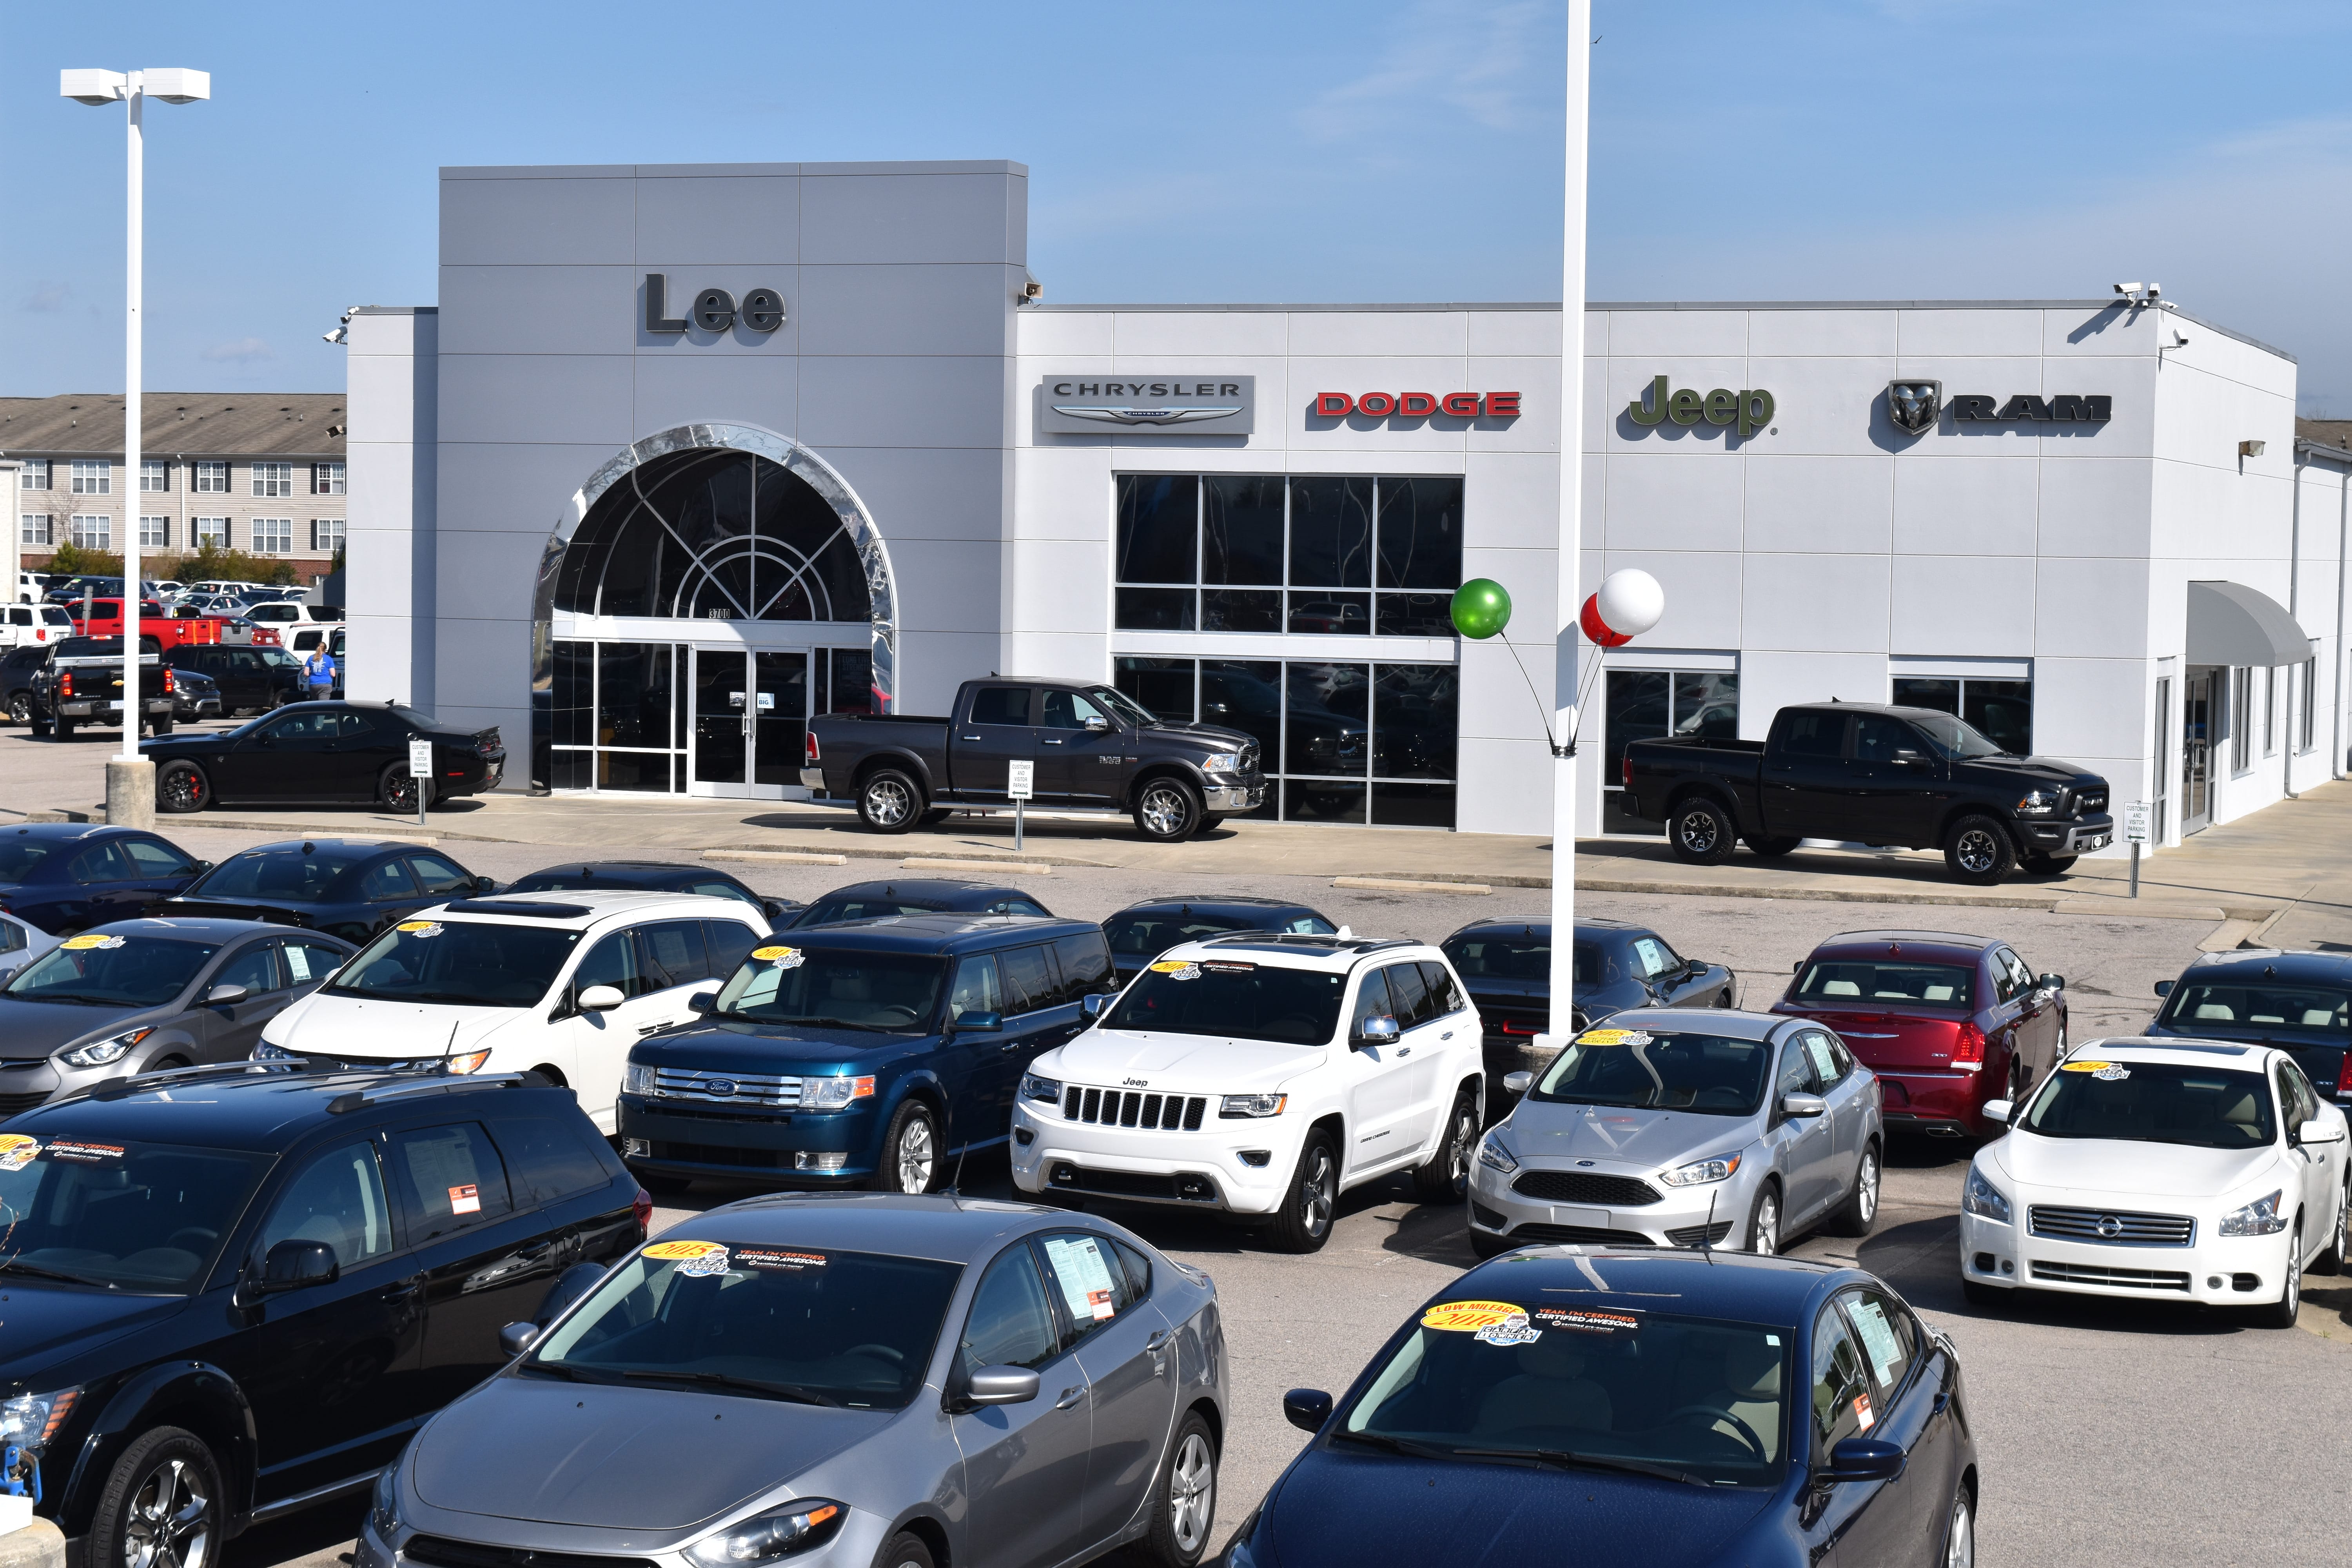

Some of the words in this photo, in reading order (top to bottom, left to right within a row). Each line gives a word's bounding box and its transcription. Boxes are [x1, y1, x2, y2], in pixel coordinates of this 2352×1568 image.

[645, 274, 785, 332] Lee
[1053, 383, 1240, 397] CHRYSLER
[1317, 392, 1522, 416] DODGE
[1630, 375, 1776, 436] Jeep
[1953, 395, 2112, 420] RAM
[710, 609, 730, 618] 3700
[710, 1082, 729, 1091] Ford
[1123, 1077, 1148, 1088] Jeep
[84, 1148, 124, 1157] AWESOME.
[85, 1143, 125, 1152] CERTIFIED.
[648, 1244, 715, 1255] 2015
[779, 1257, 827, 1266] AWESOME.
[780, 1252, 826, 1261] CERTIFIED.
[1436, 1304, 1465, 1312] LOW
[1468, 1303, 1519, 1314] MILEAGE
[1430, 1313, 1506, 1326] 2016
[1535, 1314, 1585, 1322] CERTIFIED
[1585, 1318, 1639, 1328] AWESOME.
[1584, 1312, 1636, 1323] CERTIFIED.
[1484, 1327, 1535, 1336] CARFAX
